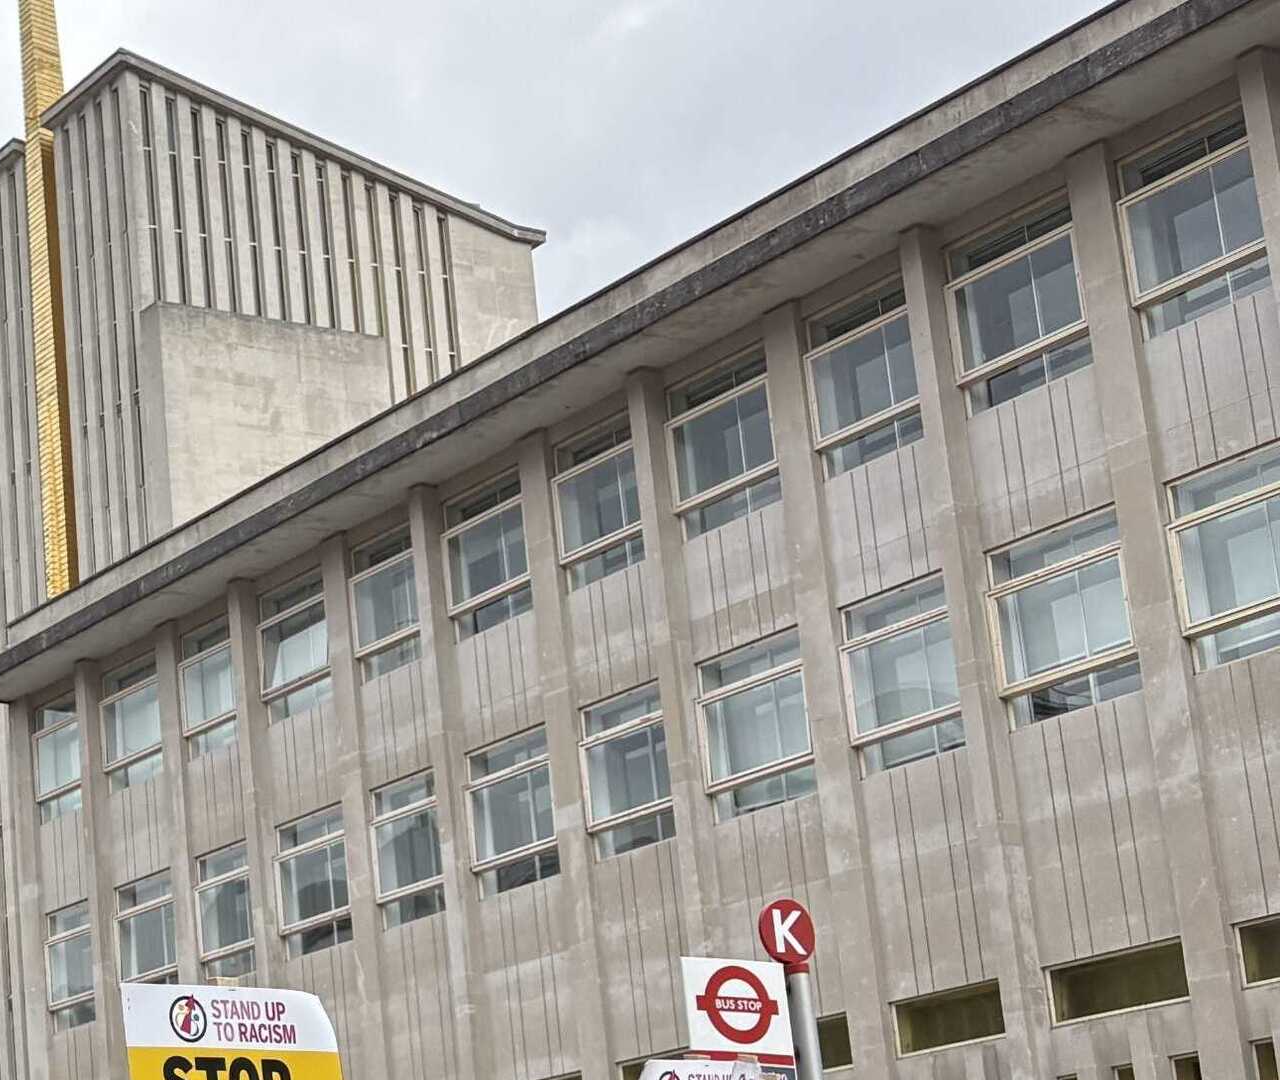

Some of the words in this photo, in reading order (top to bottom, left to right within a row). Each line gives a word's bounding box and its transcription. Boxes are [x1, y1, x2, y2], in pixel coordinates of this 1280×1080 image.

[772, 908, 807, 955] K
[211, 1000, 261, 1021] STAND
[265, 1002, 286, 1021] UP
[715, 999, 735, 1010] BUS
[737, 1000, 762, 1011] STOP
[213, 1022, 235, 1041] TO
[240, 1024, 296, 1044] RACISM
